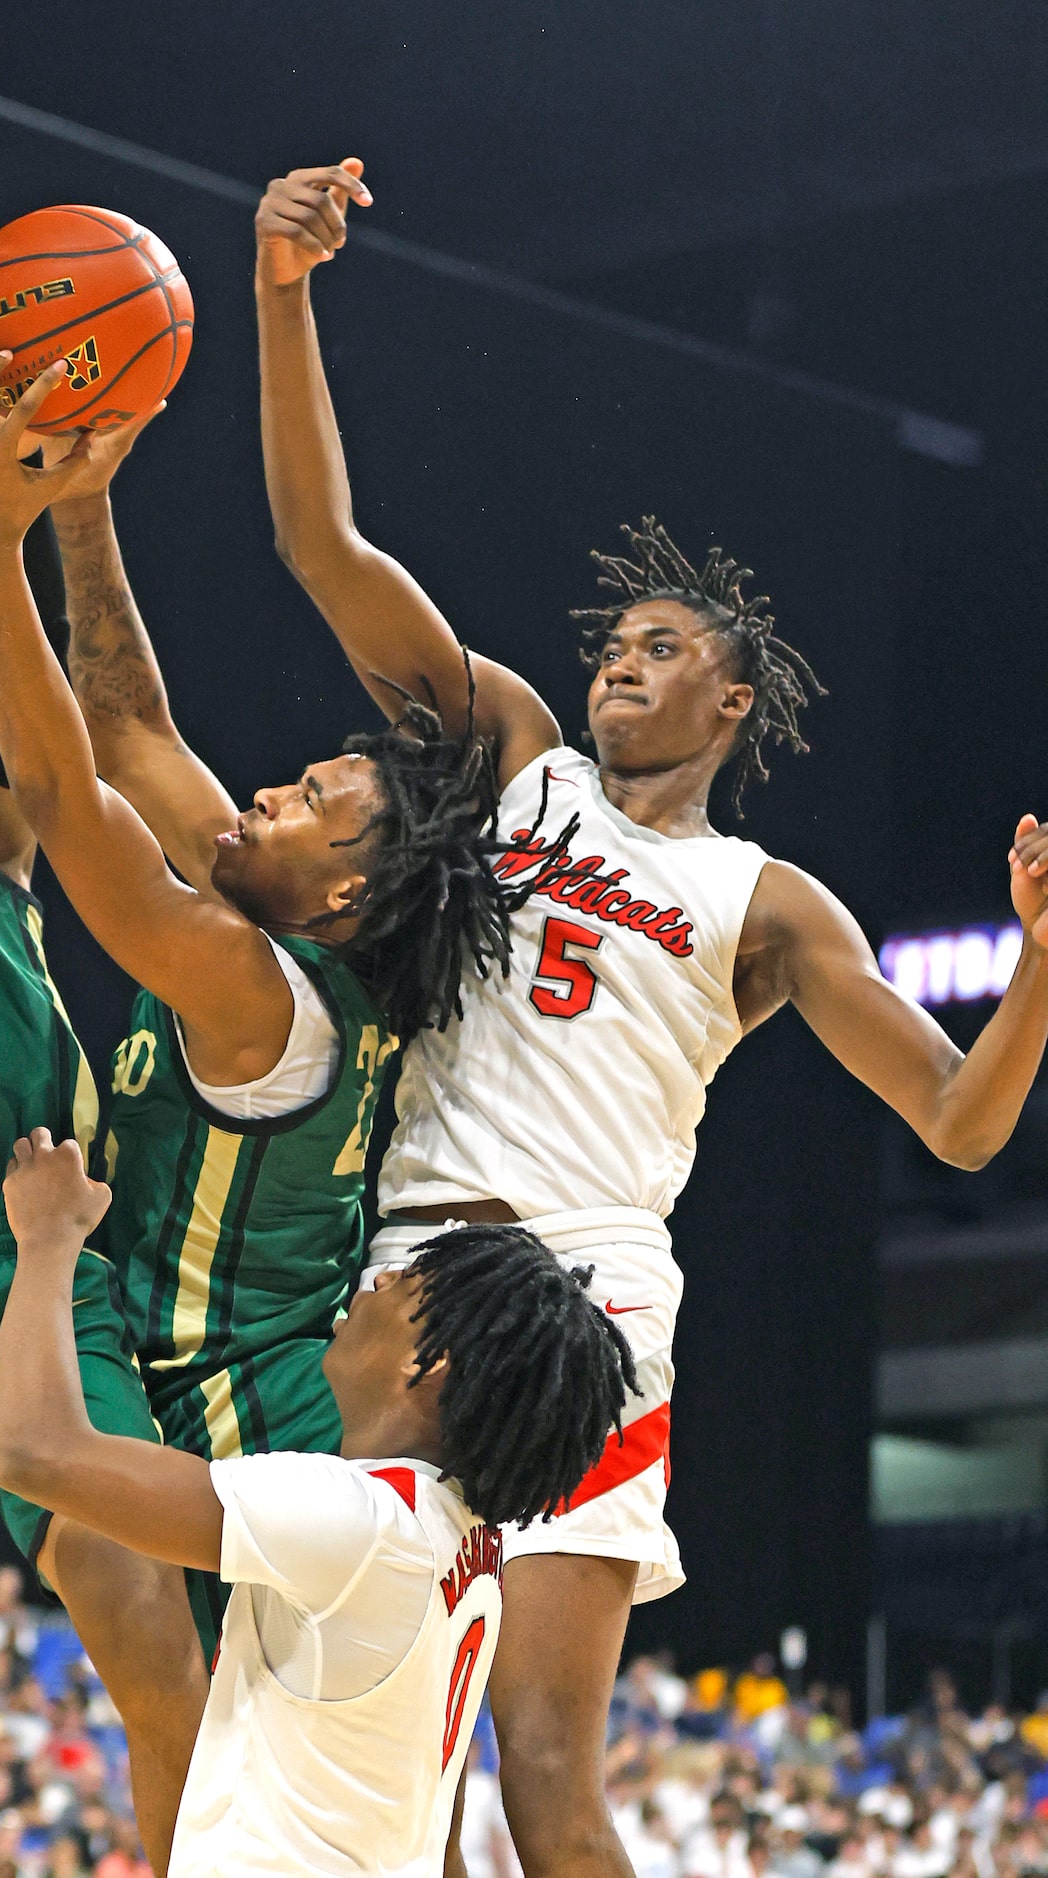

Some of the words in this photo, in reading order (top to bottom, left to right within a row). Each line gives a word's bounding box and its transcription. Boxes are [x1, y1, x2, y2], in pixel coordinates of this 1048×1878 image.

[491, 828, 694, 958] Wildcats
[527, 914, 605, 1023] 5
[440, 1613, 486, 1776] 0
